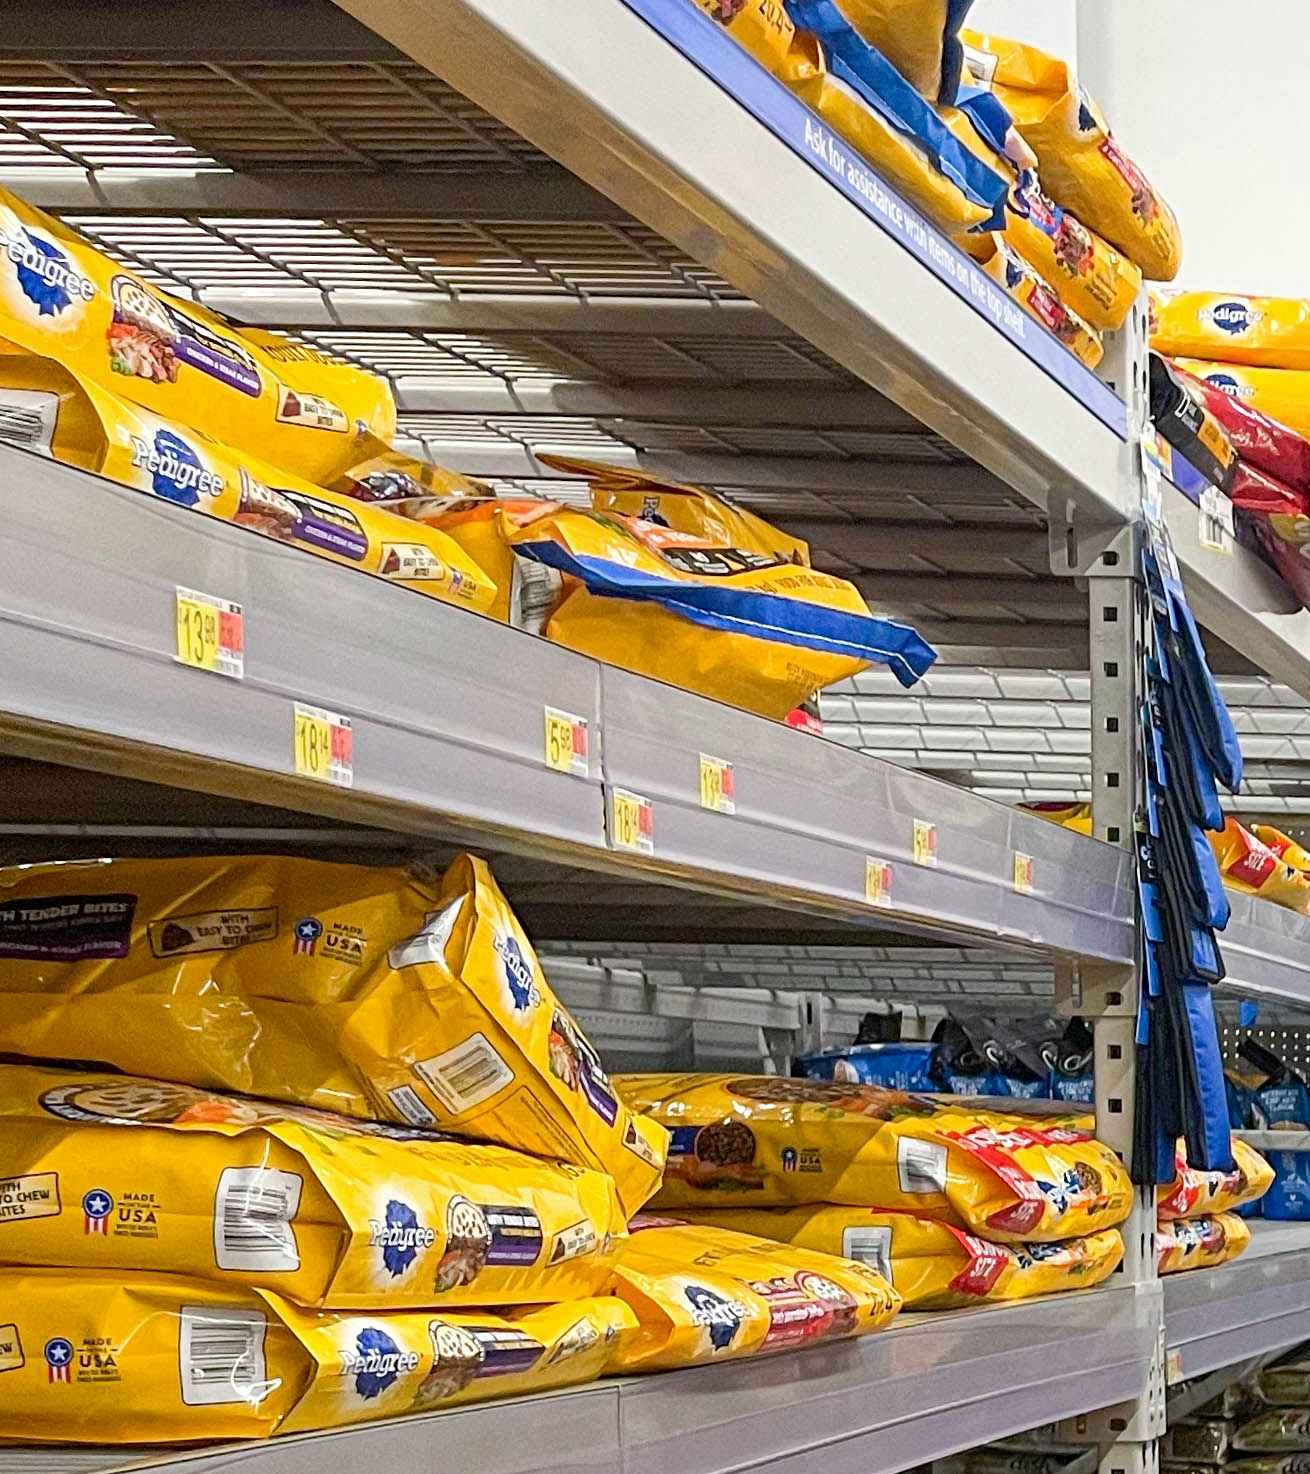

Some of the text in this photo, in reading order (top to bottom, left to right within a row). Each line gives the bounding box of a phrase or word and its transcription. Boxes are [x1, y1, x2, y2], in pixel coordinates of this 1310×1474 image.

[804, 118, 830, 161] Ask
[826, 143, 848, 181] for
[846, 158, 904, 231] assistance
[903, 213, 928, 253] with
[927, 231, 957, 280] items
[969, 264, 988, 303] the
[986, 285, 1005, 327] top
[132, 436, 224, 496] Pedigree
[20, 902, 132, 922] TENDER BITES
[333, 922, 363, 934] MADE
[326, 935, 362, 954] USA
[17, 1190, 50, 1203] CHEW
[123, 1193, 155, 1202] MADE
[118, 1208, 157, 1224] USA
[368, 1219, 436, 1250] Pedigree
[79, 1354, 118, 1368] USA
[339, 1350, 421, 1376] Pedigree
